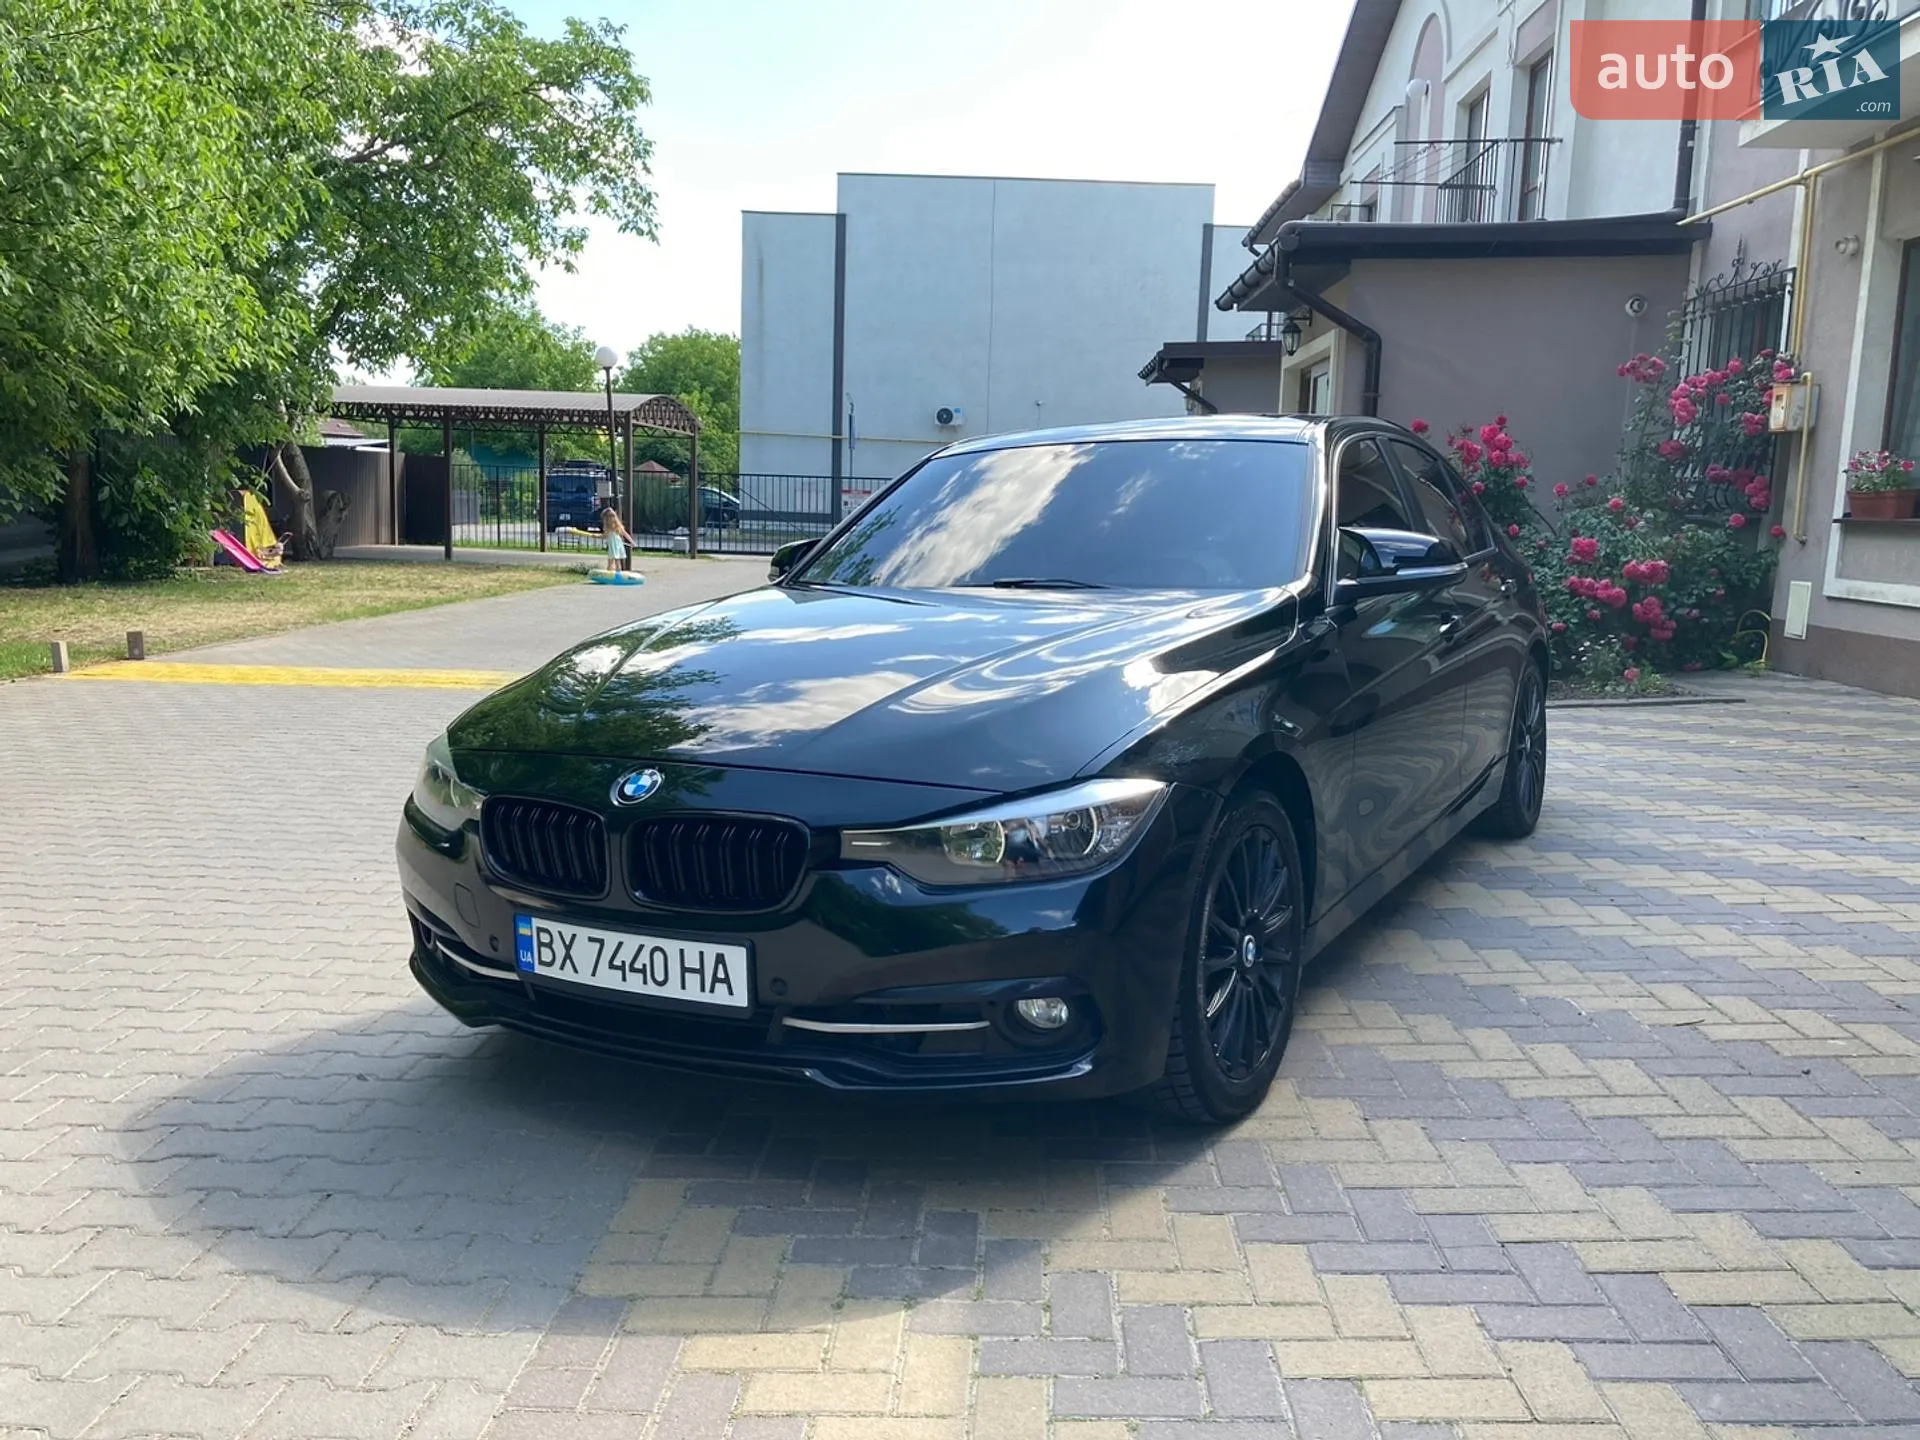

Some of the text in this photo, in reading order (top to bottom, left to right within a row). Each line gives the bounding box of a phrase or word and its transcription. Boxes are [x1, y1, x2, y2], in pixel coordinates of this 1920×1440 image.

[520, 950, 533, 964] UA
[536, 926, 734, 996] BX 7440 HA
